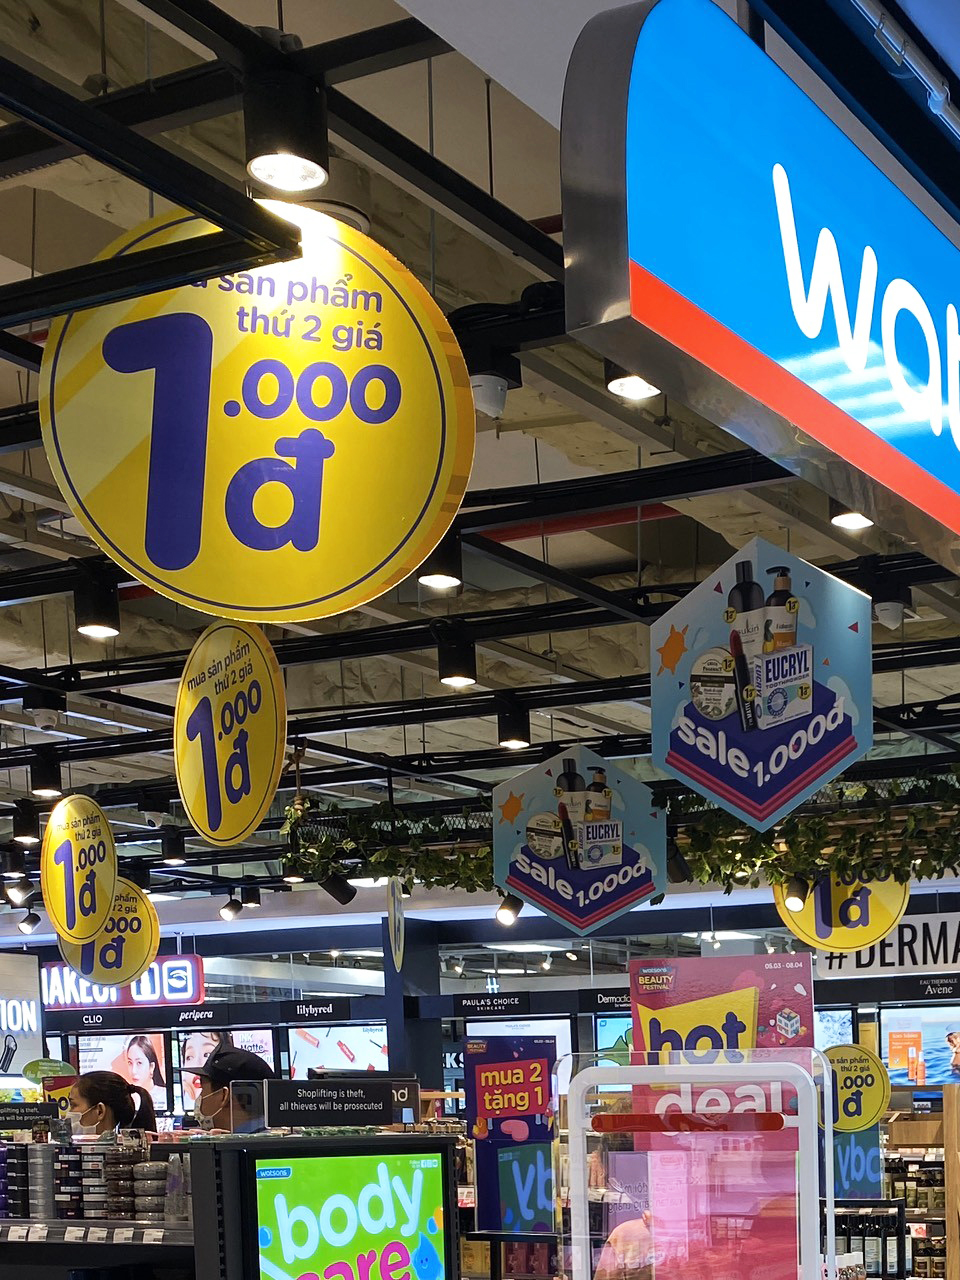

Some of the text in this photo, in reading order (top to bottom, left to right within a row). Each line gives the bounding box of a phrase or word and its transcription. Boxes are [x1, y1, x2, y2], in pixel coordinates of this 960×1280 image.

[287, 274, 383, 313] phẩm
[236, 306, 384, 352] thứ 2 giá
[224, 428, 335, 552] đ
[187, 640, 250, 692] mua sản phẩm
[214, 659, 253, 695] thứ 2 giá
[766, 650, 809, 683] EUCRYL
[677, 715, 750, 778] sale
[225, 728, 251, 804] đ
[87, 829, 92, 839] 2
[586, 823, 620, 841] EUCRYL
[515, 853, 574, 900] sale
[79, 869, 96, 917] đ
[118, 904, 123, 912] 2
[839, 886, 872, 929] đ
[99, 935, 126, 969] đ
[639, 976, 674, 985] BEAUTY
[83, 1015, 103, 1024] CLIO
[179, 1010, 213, 1021] peripera
[297, 1003, 333, 1015] lilybyred
[240, 1033, 254, 1042] INK
[648, 1012, 746, 1065] hot
[481, 1062, 542, 1087] mua 2
[47, 1094, 70, 1111] ho
[279, 1101, 383, 1112] all thieves will be prosecuted
[298, 1089, 366, 1099] Shoplifting is theft,
[392, 1087, 408, 1101] nd
[484, 1086, 543, 1114] tặng 1
[843, 1090, 863, 1117] đ
[655, 1082, 783, 1137] deal
[260, 1169, 287, 1177] watsons
[274, 1162, 423, 1264] body
